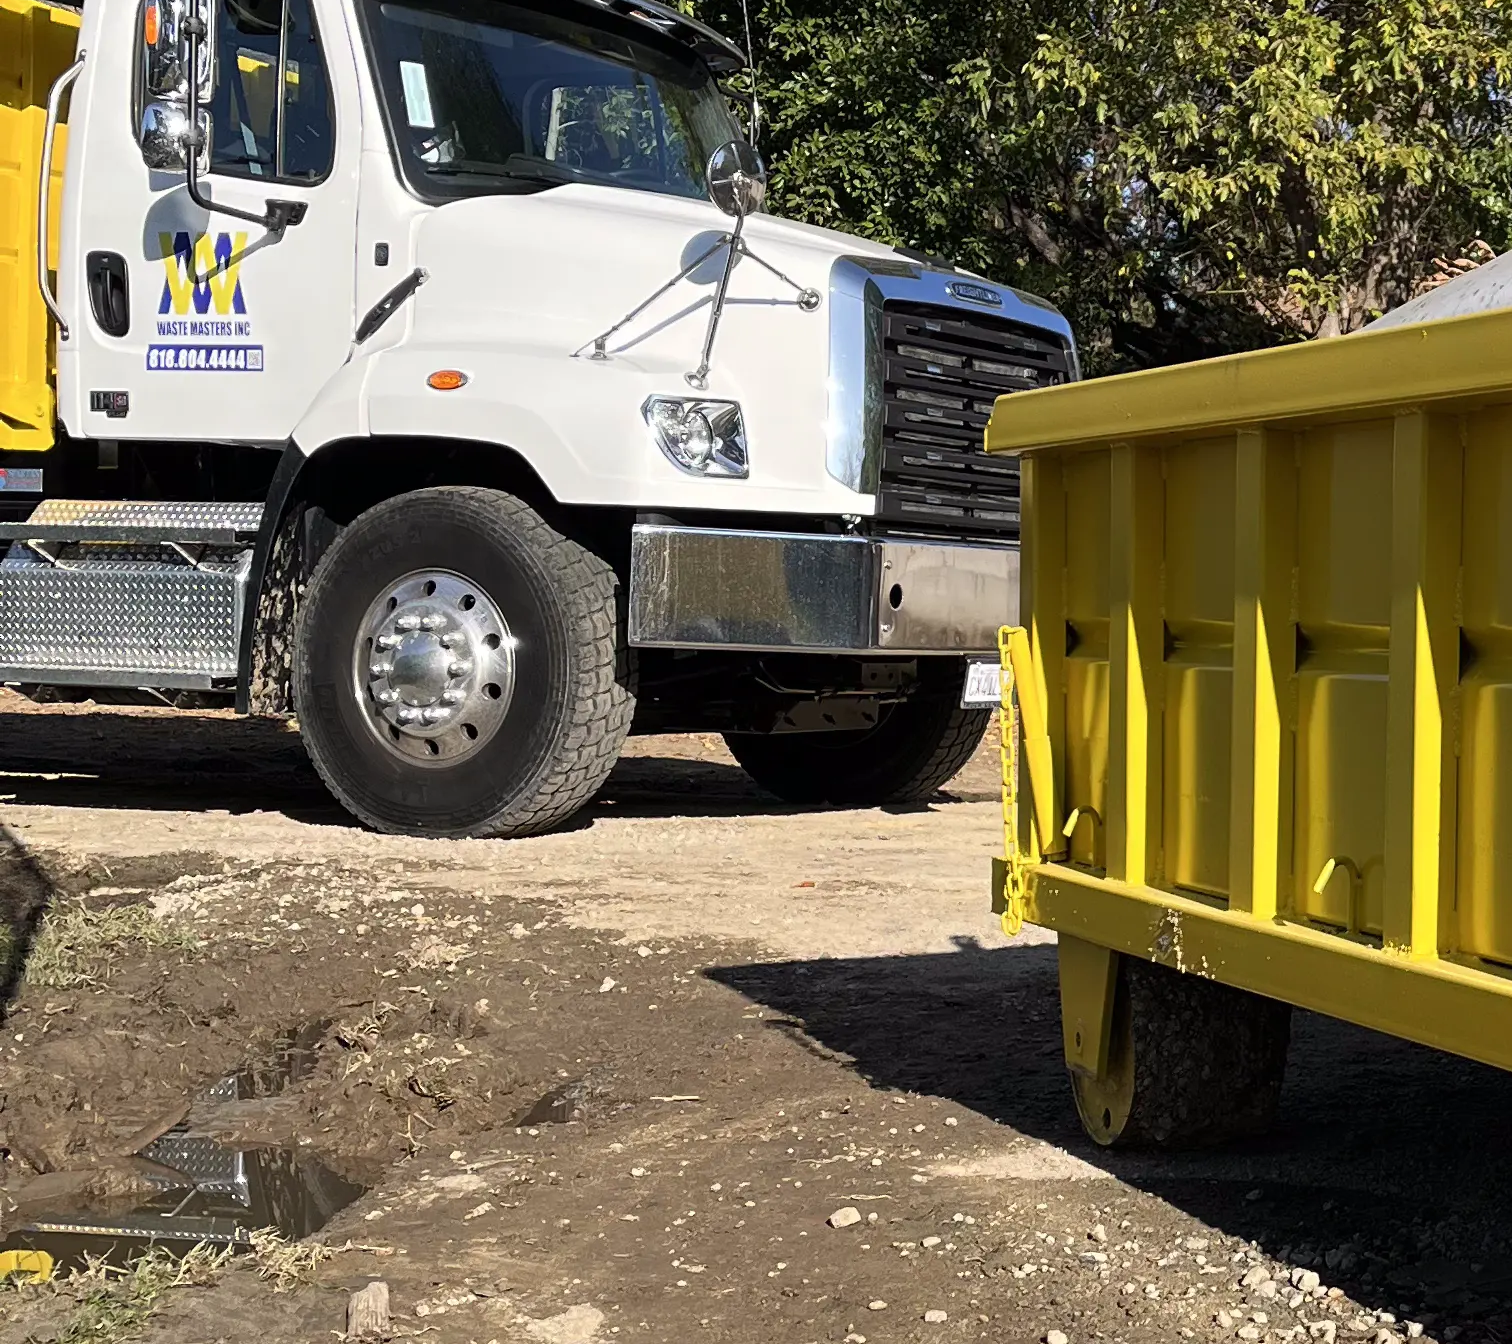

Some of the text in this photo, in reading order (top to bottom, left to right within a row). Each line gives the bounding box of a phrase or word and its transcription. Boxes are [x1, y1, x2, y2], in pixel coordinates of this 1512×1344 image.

[157, 321, 251, 337] WASTE MASTERS INC
[148, 348, 246, 369] 818.804.4444
